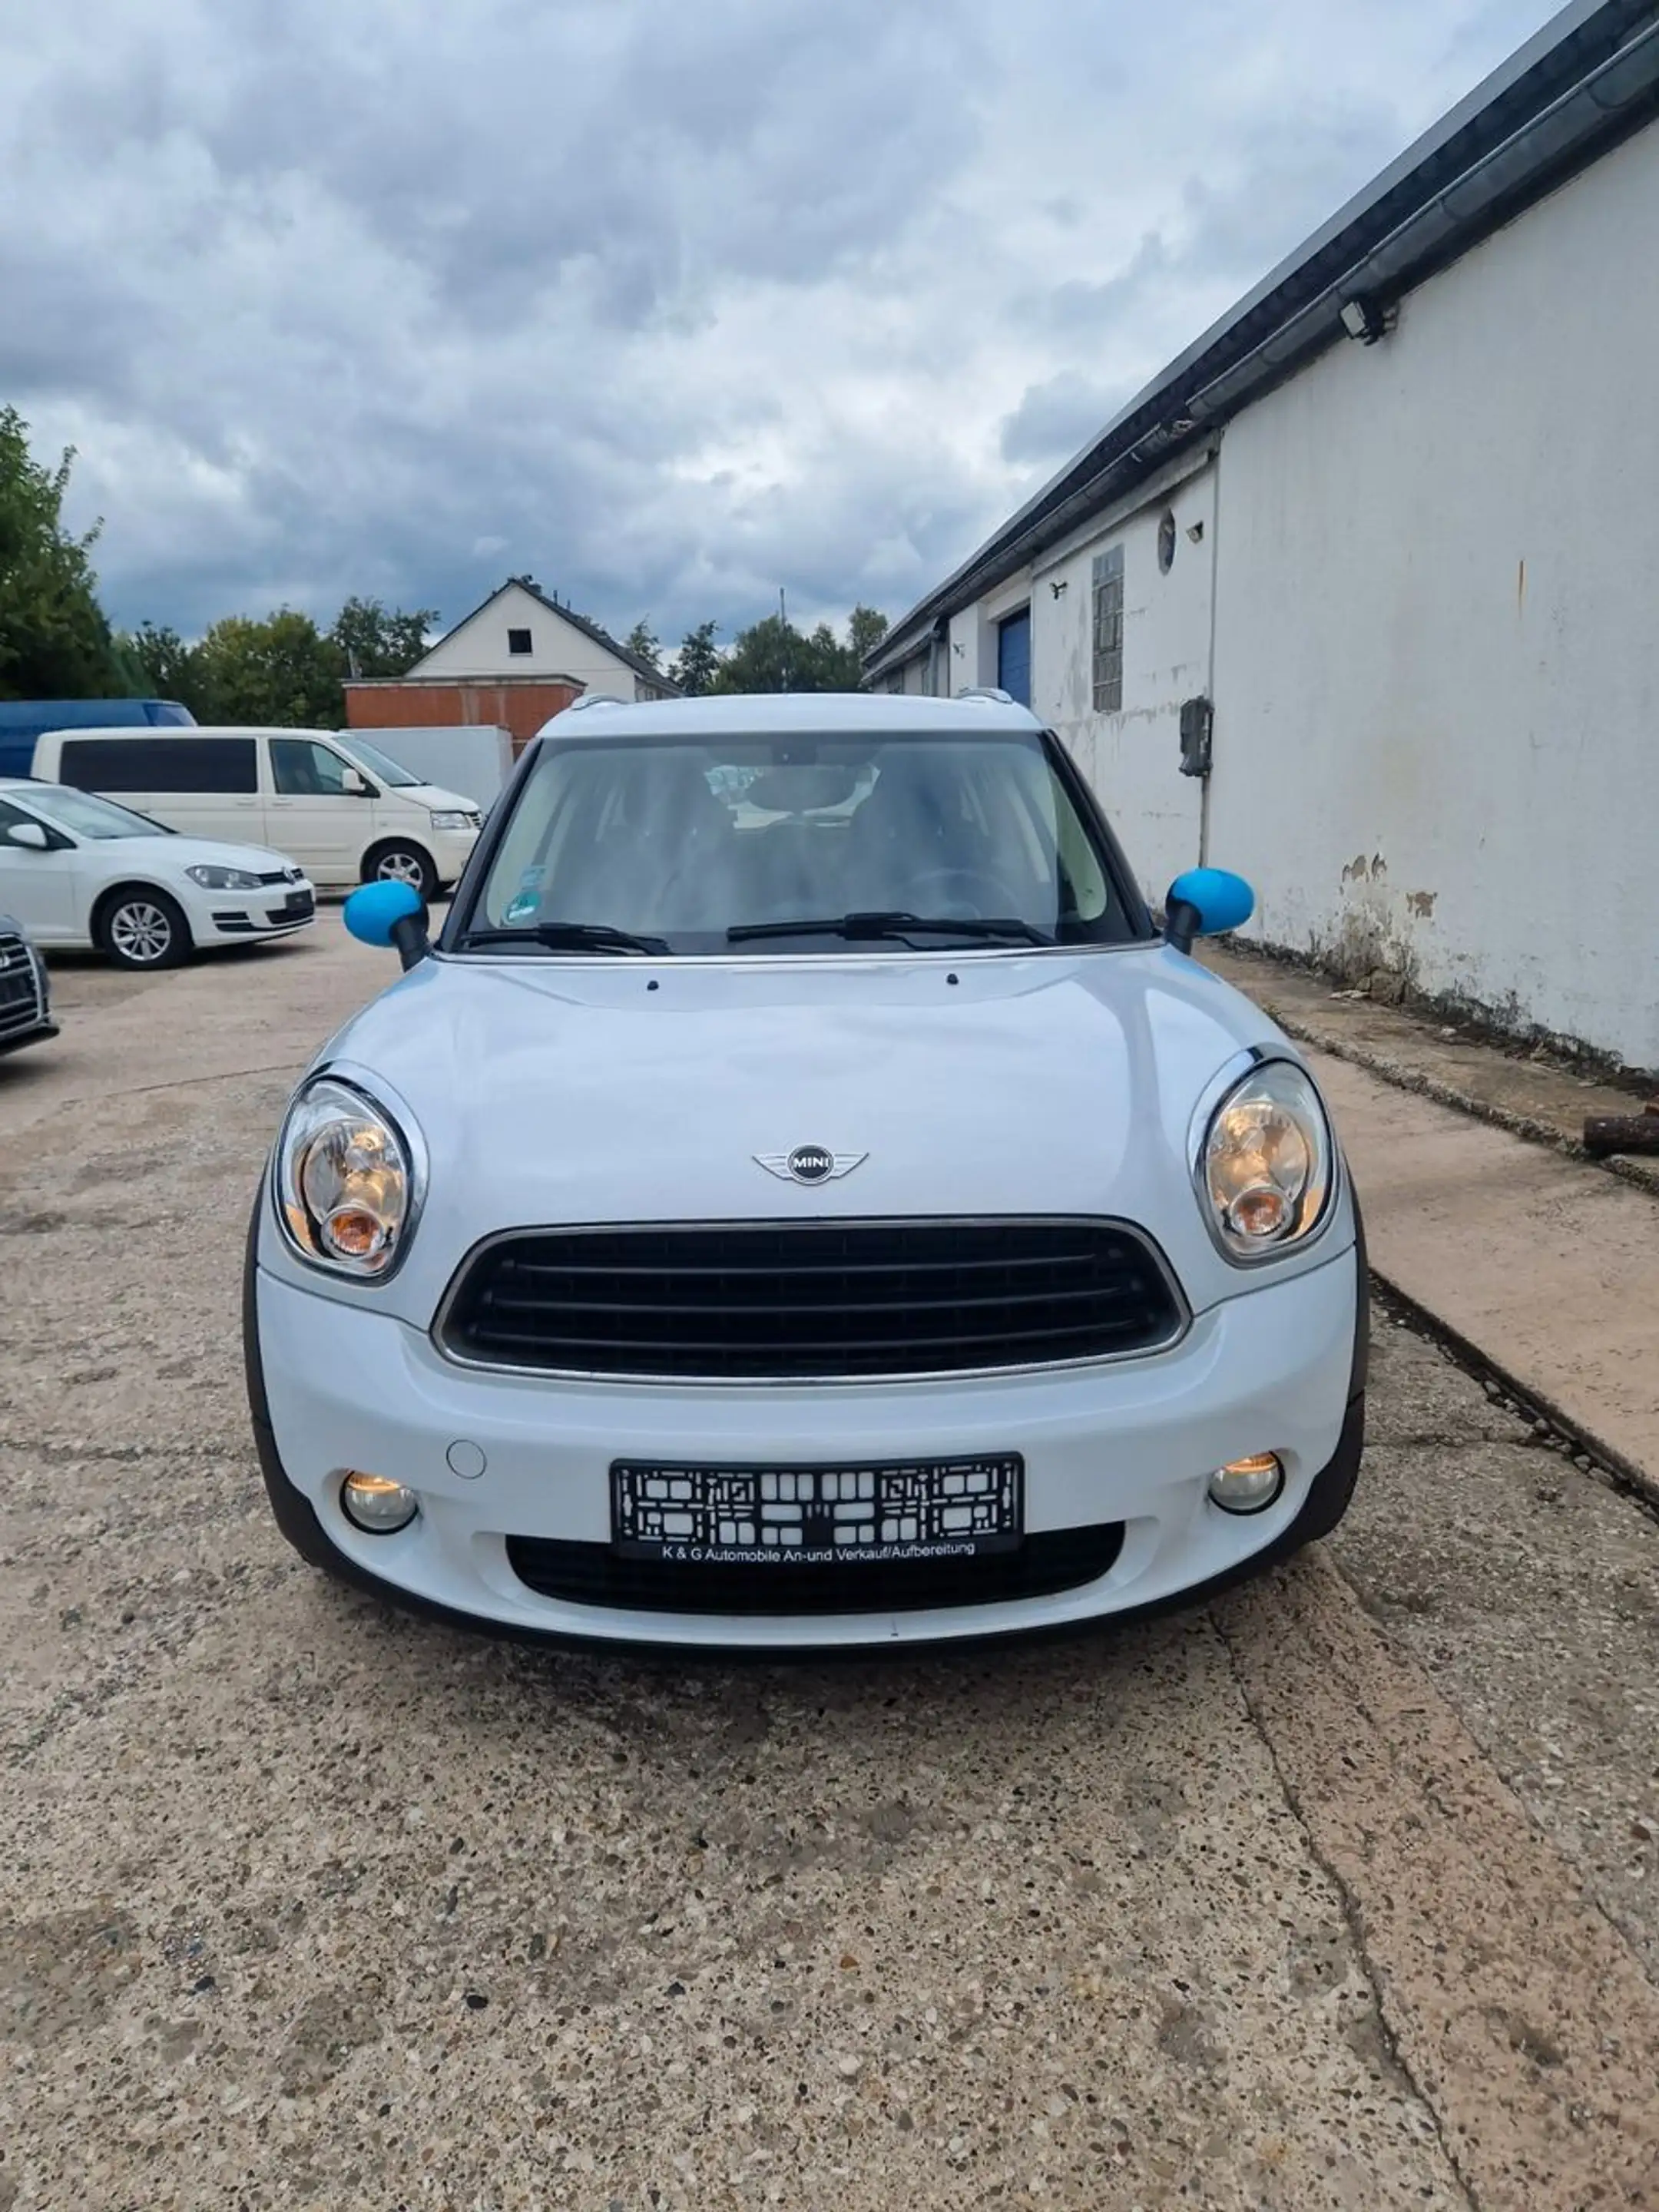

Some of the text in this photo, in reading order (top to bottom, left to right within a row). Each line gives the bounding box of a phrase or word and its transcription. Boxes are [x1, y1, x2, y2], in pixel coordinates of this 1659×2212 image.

[793, 1157, 829, 1168] MINI
[663, 1546, 673, 1558] K
[676, 1546, 687, 1559] &
[691, 1548, 702, 1561] G
[704, 1548, 781, 1562] Automobile
[783, 1548, 833, 1562] An-und
